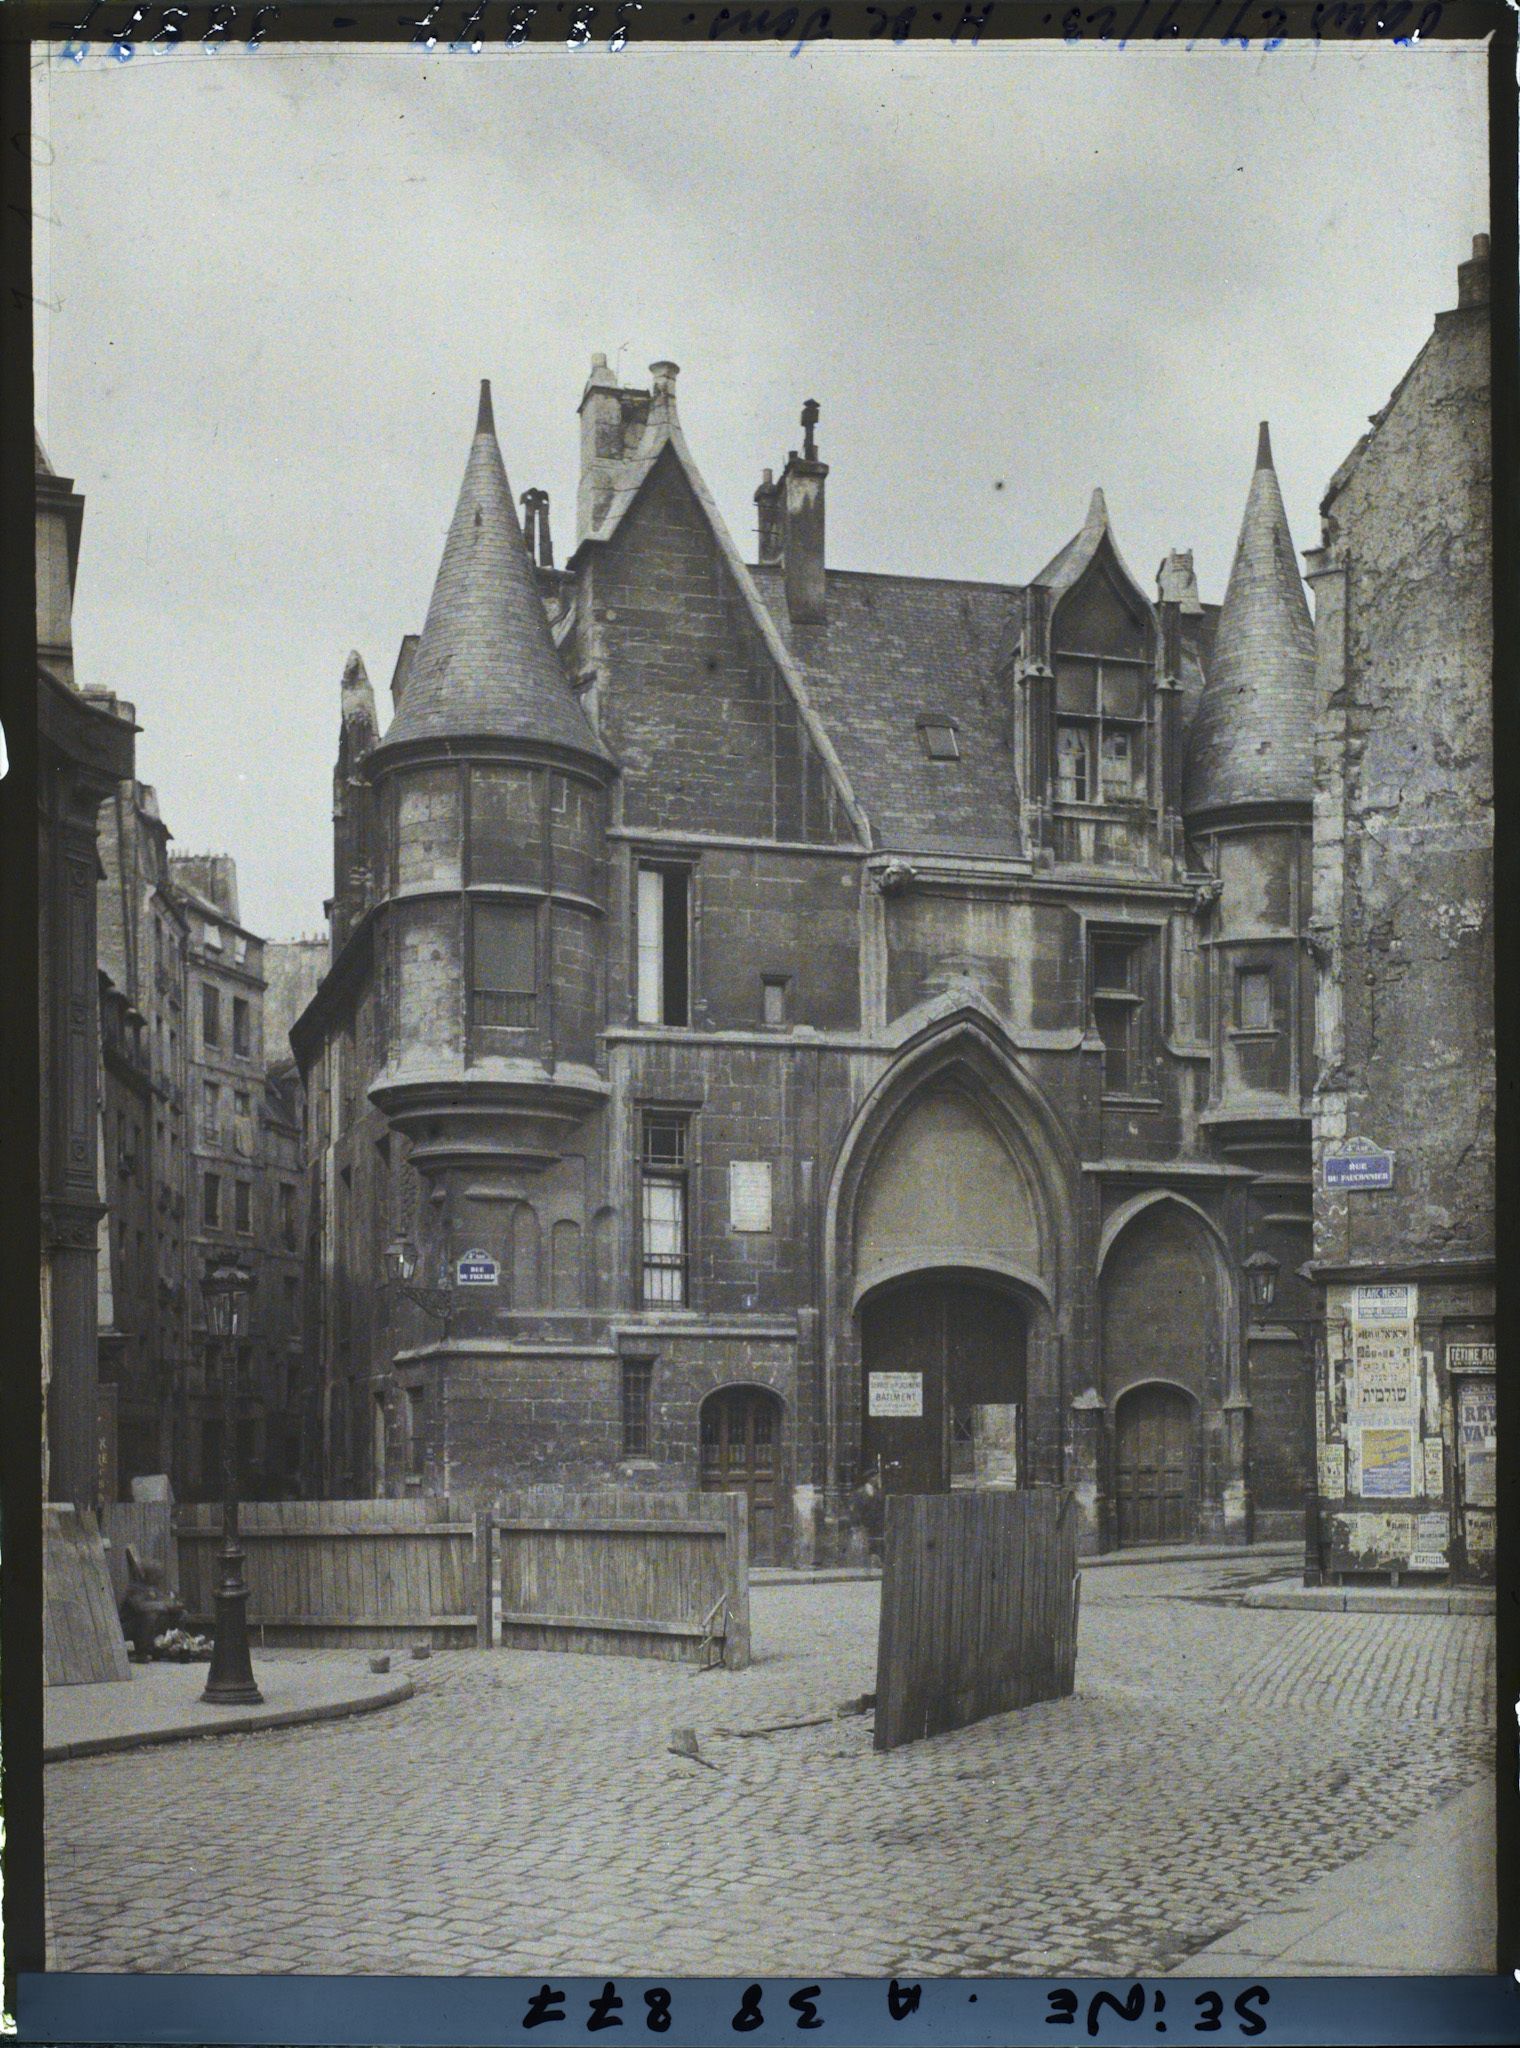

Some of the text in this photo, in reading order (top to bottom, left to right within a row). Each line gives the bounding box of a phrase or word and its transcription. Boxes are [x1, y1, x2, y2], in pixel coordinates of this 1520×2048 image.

[1348, 1162, 1368, 1170] RUE
[1327, 1172, 1388, 1182] DU FAUCONNIER
